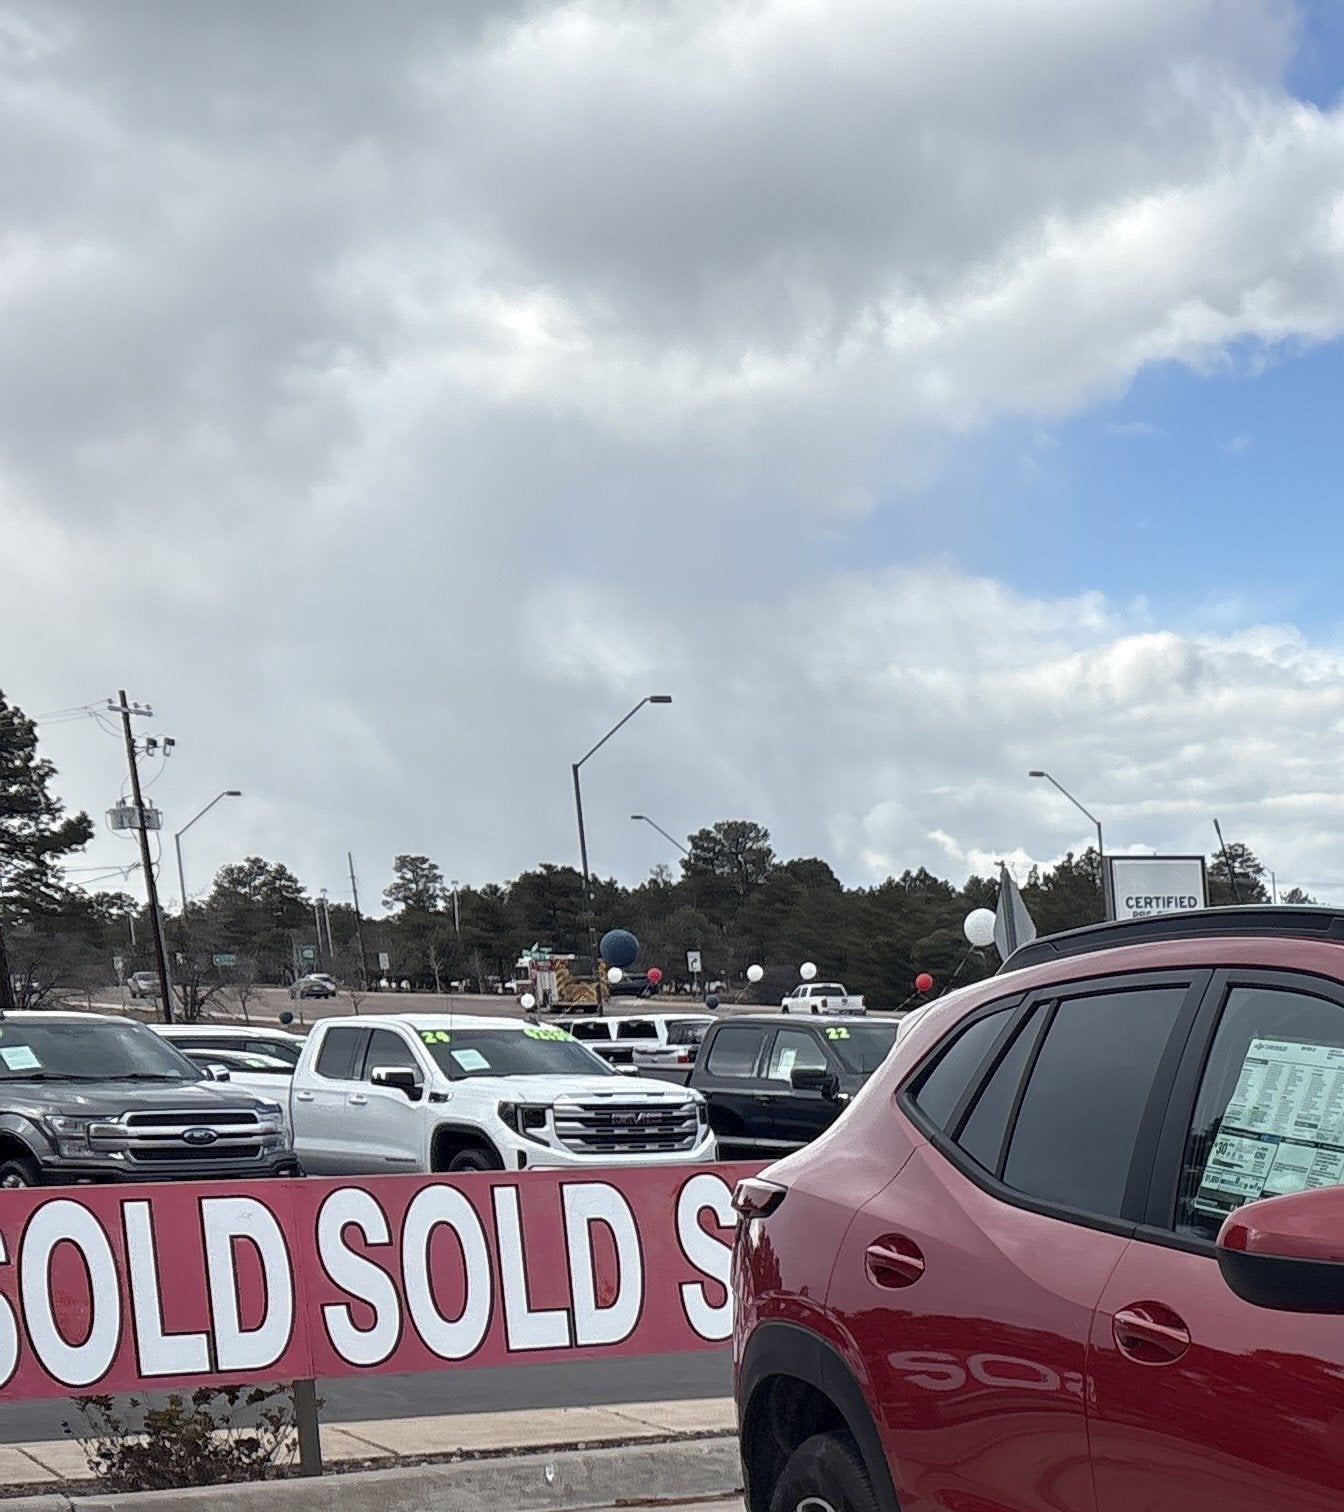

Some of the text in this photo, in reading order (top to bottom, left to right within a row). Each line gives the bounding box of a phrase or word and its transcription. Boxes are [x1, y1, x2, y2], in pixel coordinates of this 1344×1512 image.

[1125, 896, 1198, 909] CERTIFIED
[825, 1027, 850, 1040] 22
[0, 1194, 296, 1390] OLD
[316, 1181, 645, 1368] SOLD
